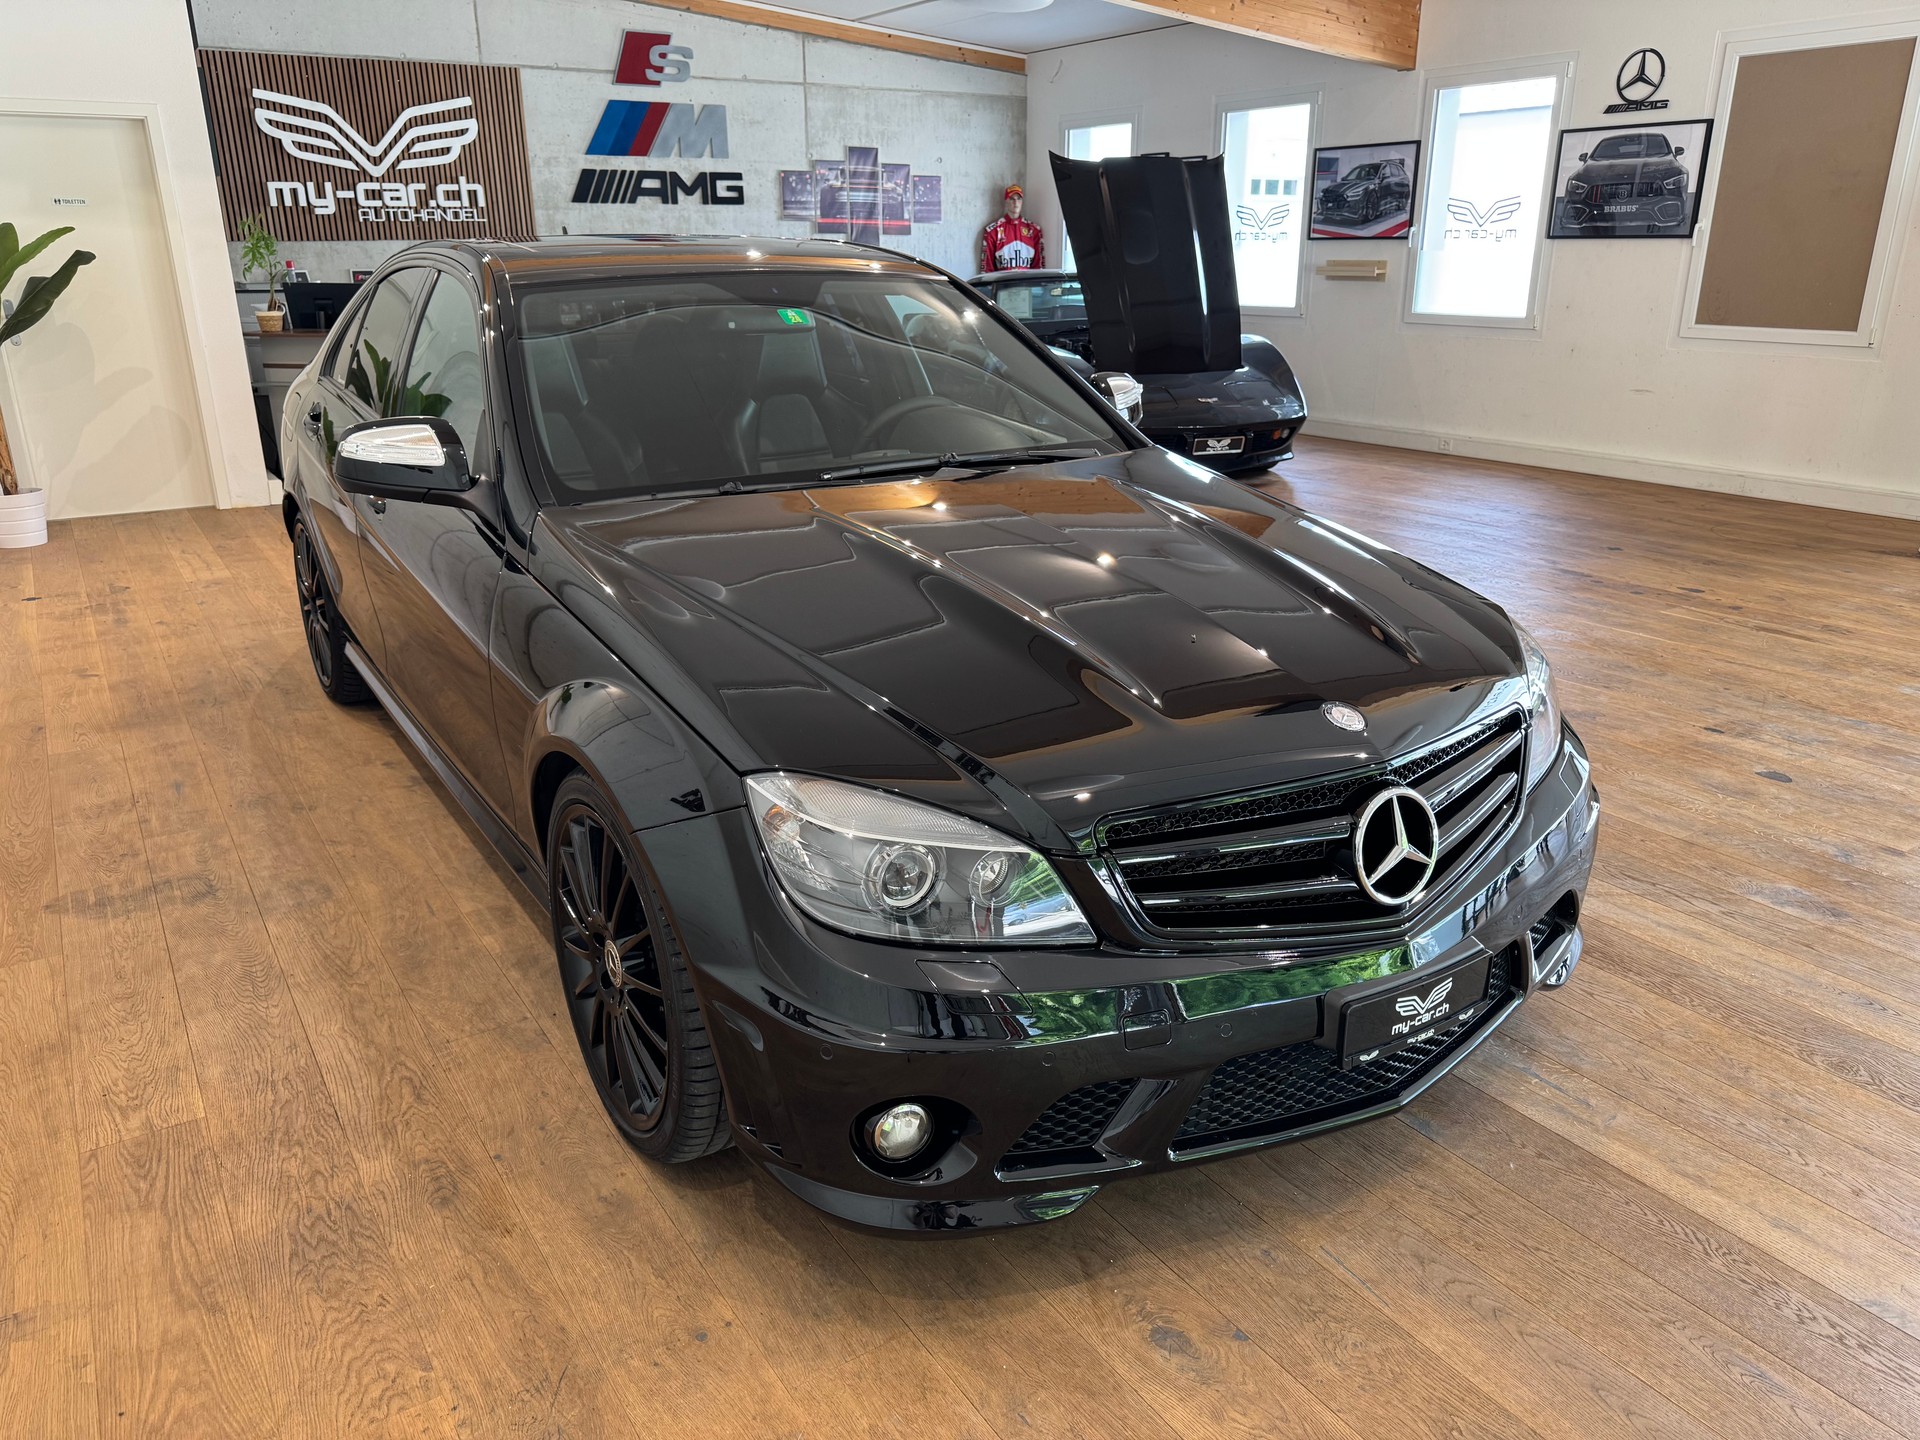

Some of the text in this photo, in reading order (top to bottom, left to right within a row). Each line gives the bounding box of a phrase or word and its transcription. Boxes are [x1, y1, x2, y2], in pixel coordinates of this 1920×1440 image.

[645, 44, 694, 83] S
[648, 103, 730, 159] M
[266, 176, 486, 215] my-car.ch
[627, 169, 745, 205] AMG
[358, 208, 487, 223] AUTOHANDEL
[1603, 204, 1639, 213] BRABUS
[1391, 1002, 1450, 1036] my-car.ch
